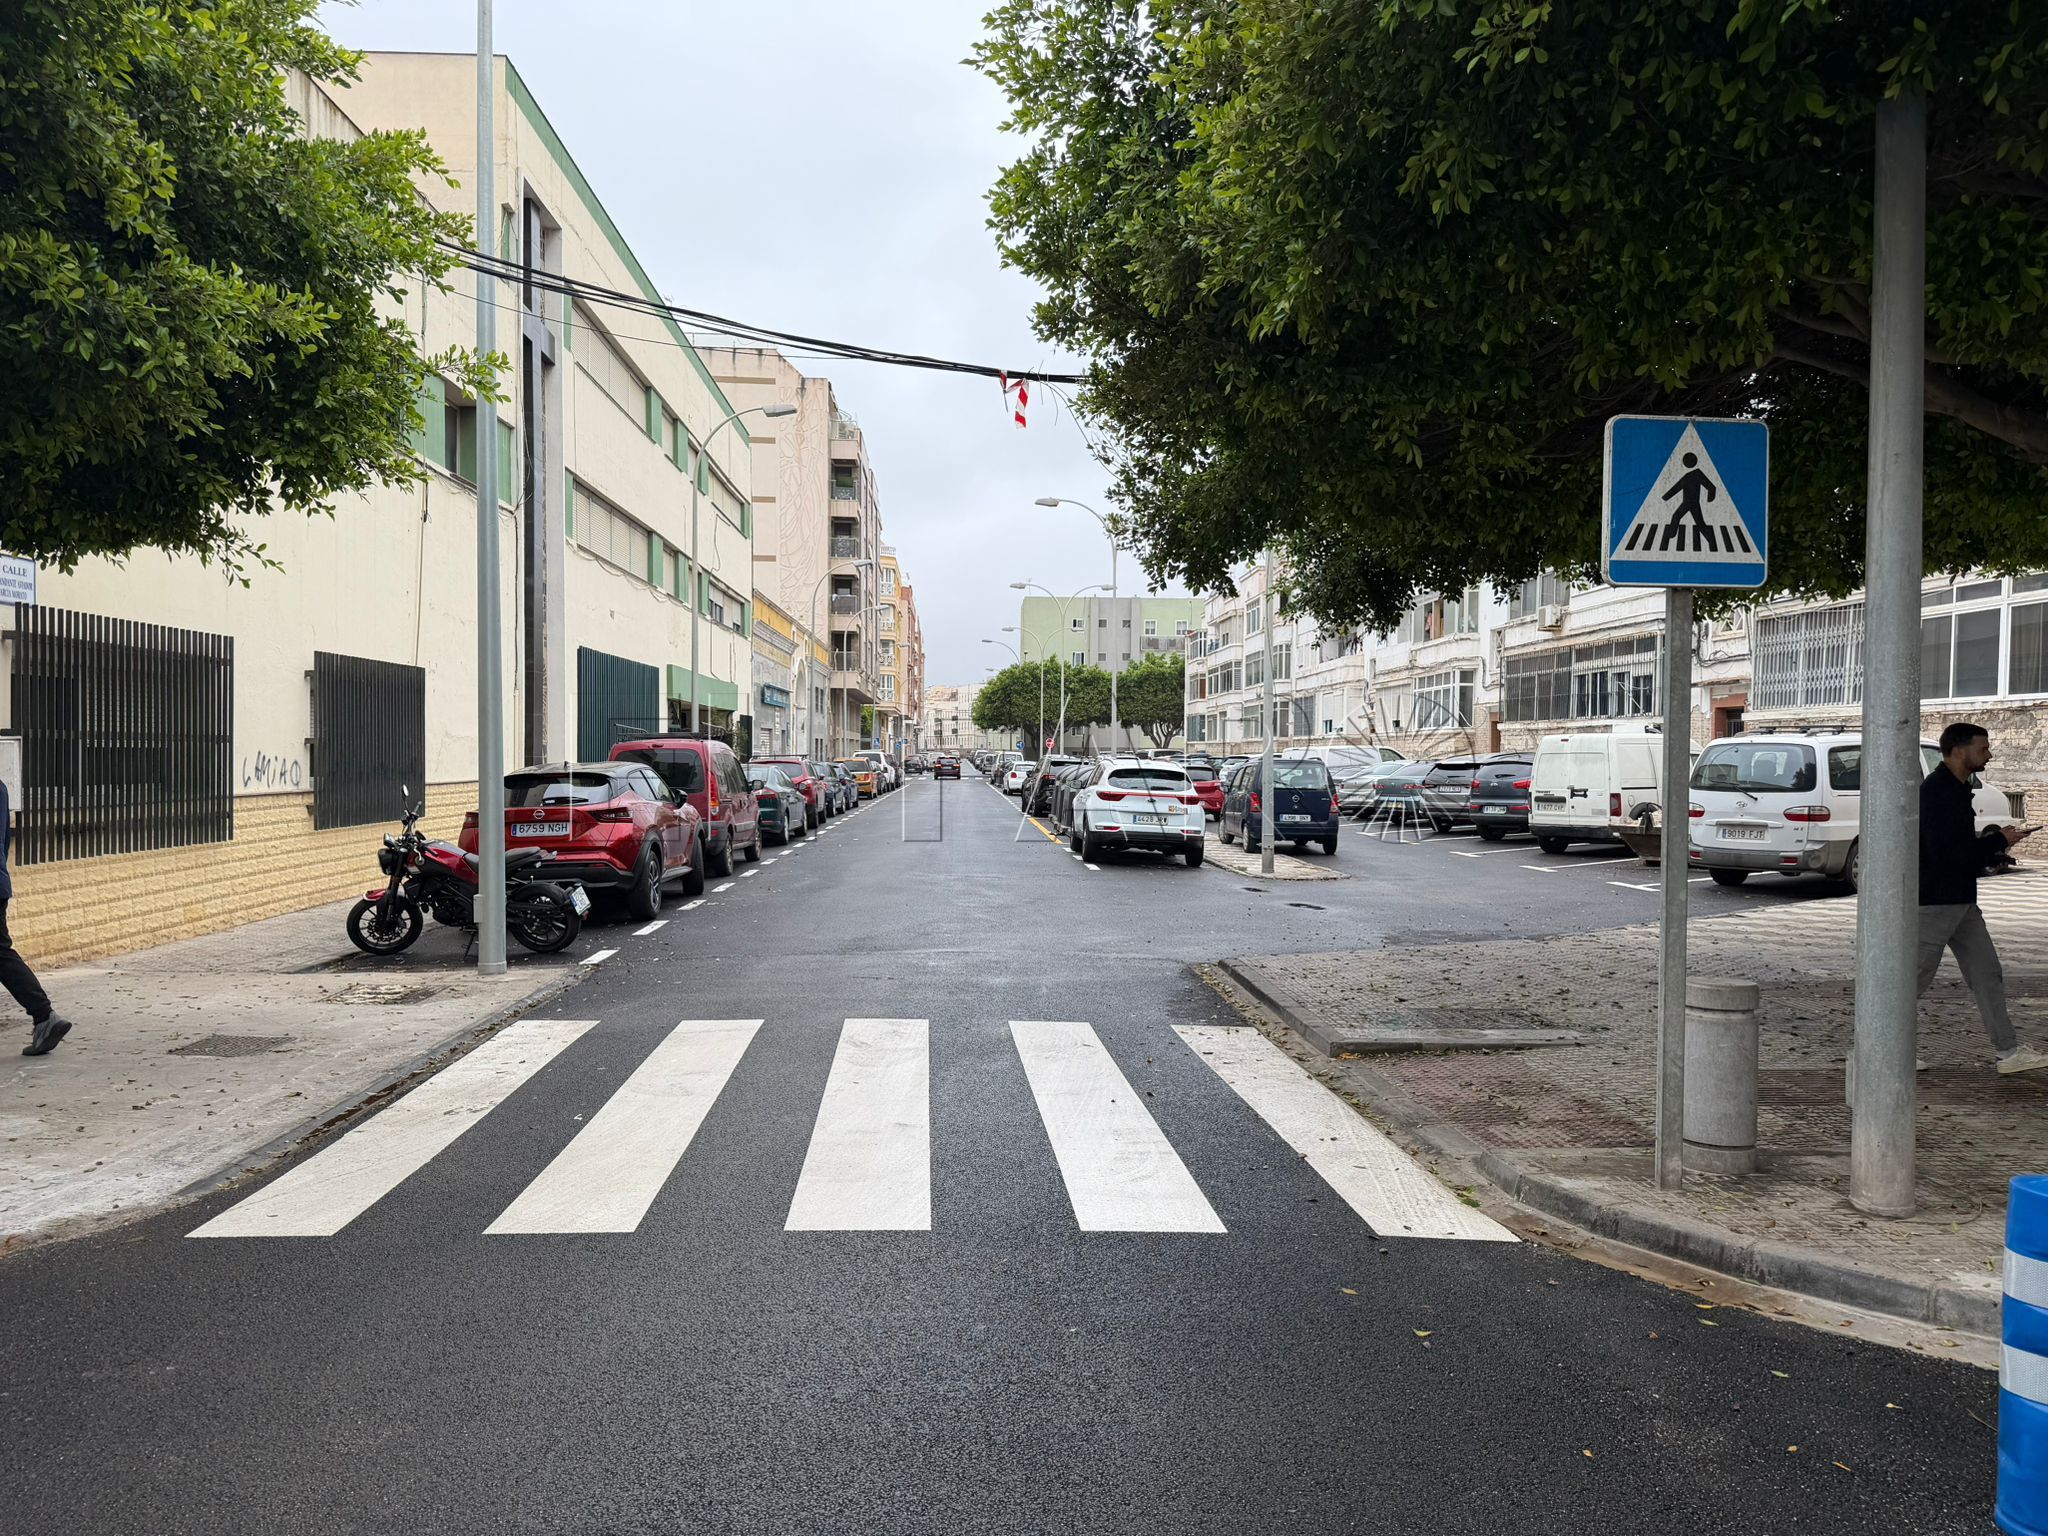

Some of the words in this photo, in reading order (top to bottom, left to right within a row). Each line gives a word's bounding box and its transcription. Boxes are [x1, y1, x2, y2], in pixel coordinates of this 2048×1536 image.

[2, 564, 28, 577] CALLE
[519, 824, 545, 834] 6759
[1727, 829, 1746, 838] 9019
